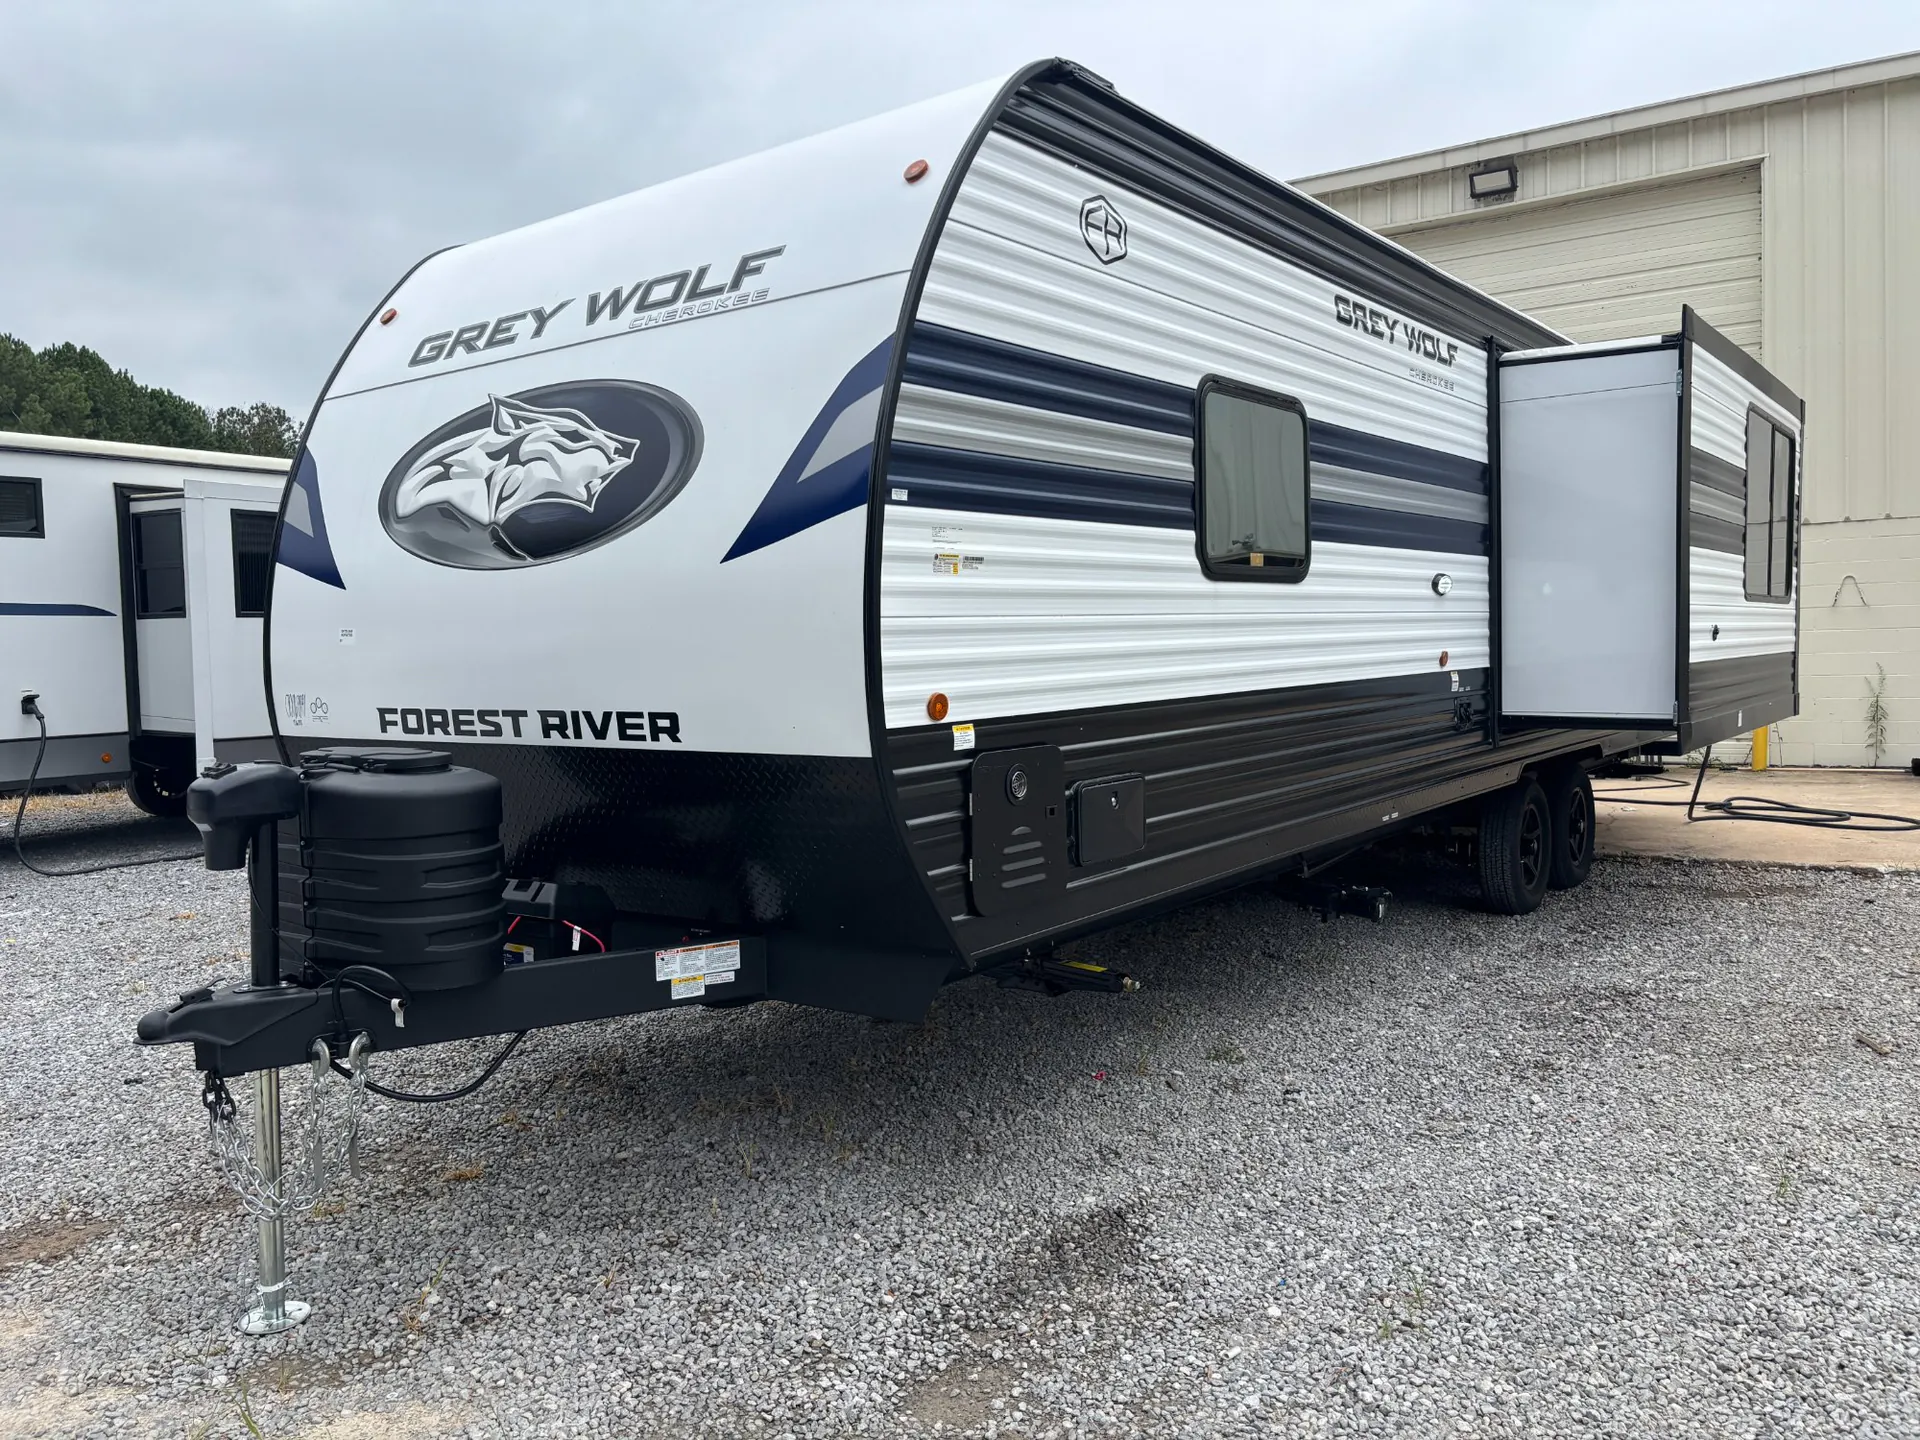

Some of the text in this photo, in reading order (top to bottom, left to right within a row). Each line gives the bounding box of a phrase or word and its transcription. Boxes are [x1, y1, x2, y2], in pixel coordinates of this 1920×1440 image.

[408, 244, 786, 367] GREY WOLF
[628, 288, 770, 329] CHEROKEE
[1334, 294, 1458, 367] GREY WOLF
[376, 707, 682, 743] FOREST RIVER
